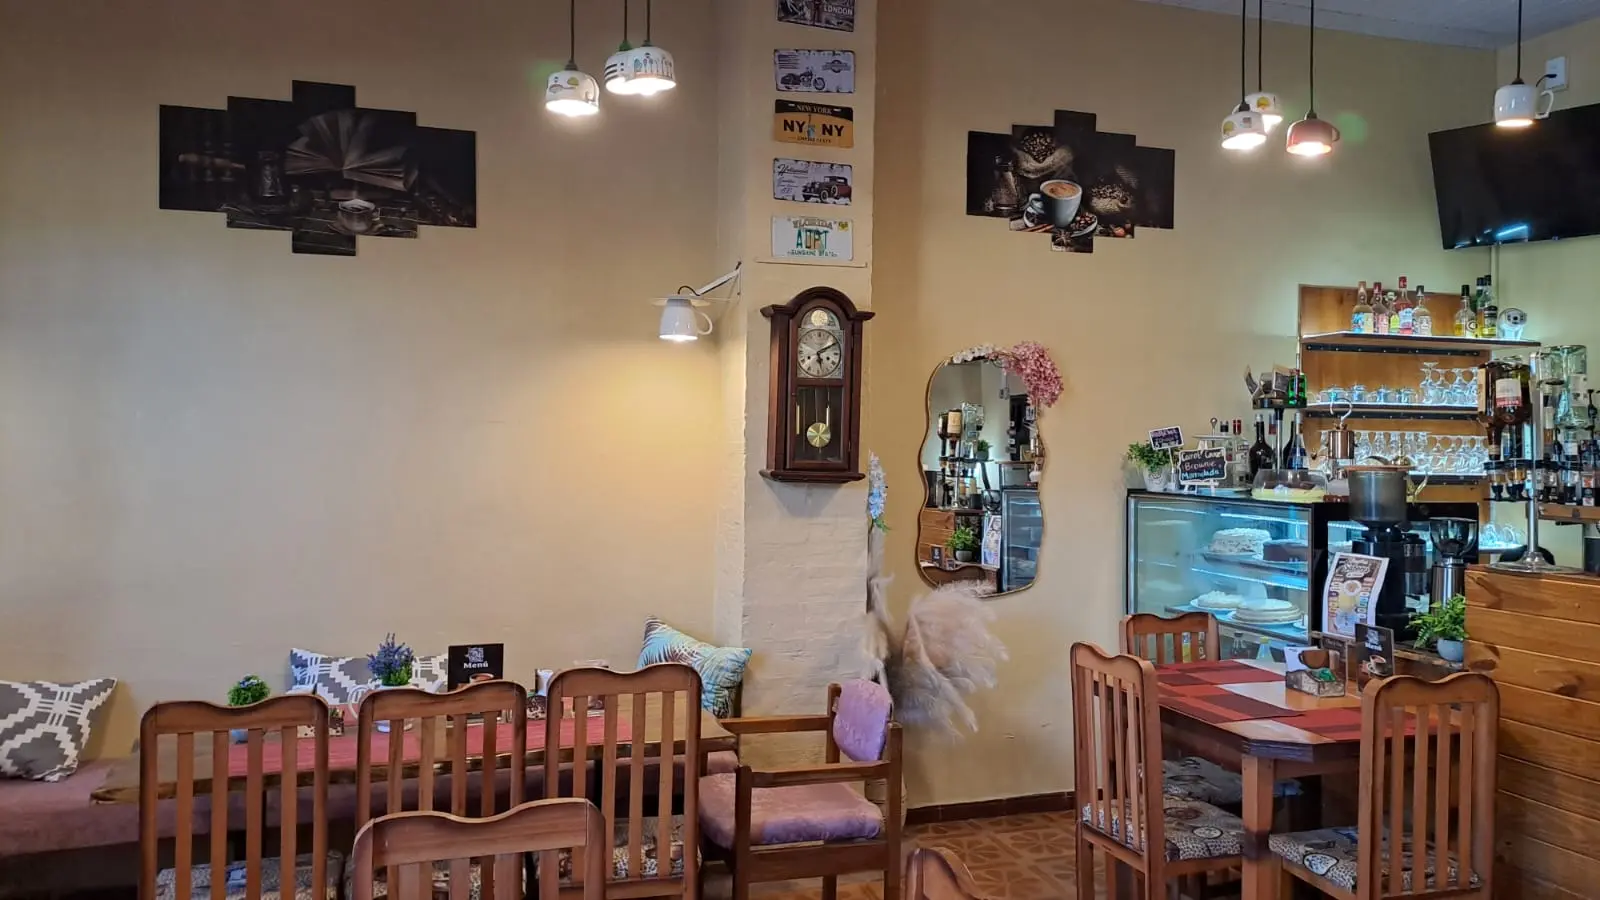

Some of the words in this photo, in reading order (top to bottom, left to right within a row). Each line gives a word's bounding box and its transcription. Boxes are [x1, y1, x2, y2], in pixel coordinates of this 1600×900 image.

[823, 5, 853, 15] LONDON
[796, 104, 811, 112] NEW
[812, 106, 833, 114] YORK
[783, 119, 805, 133] NY
[822, 123, 844, 137] NY
